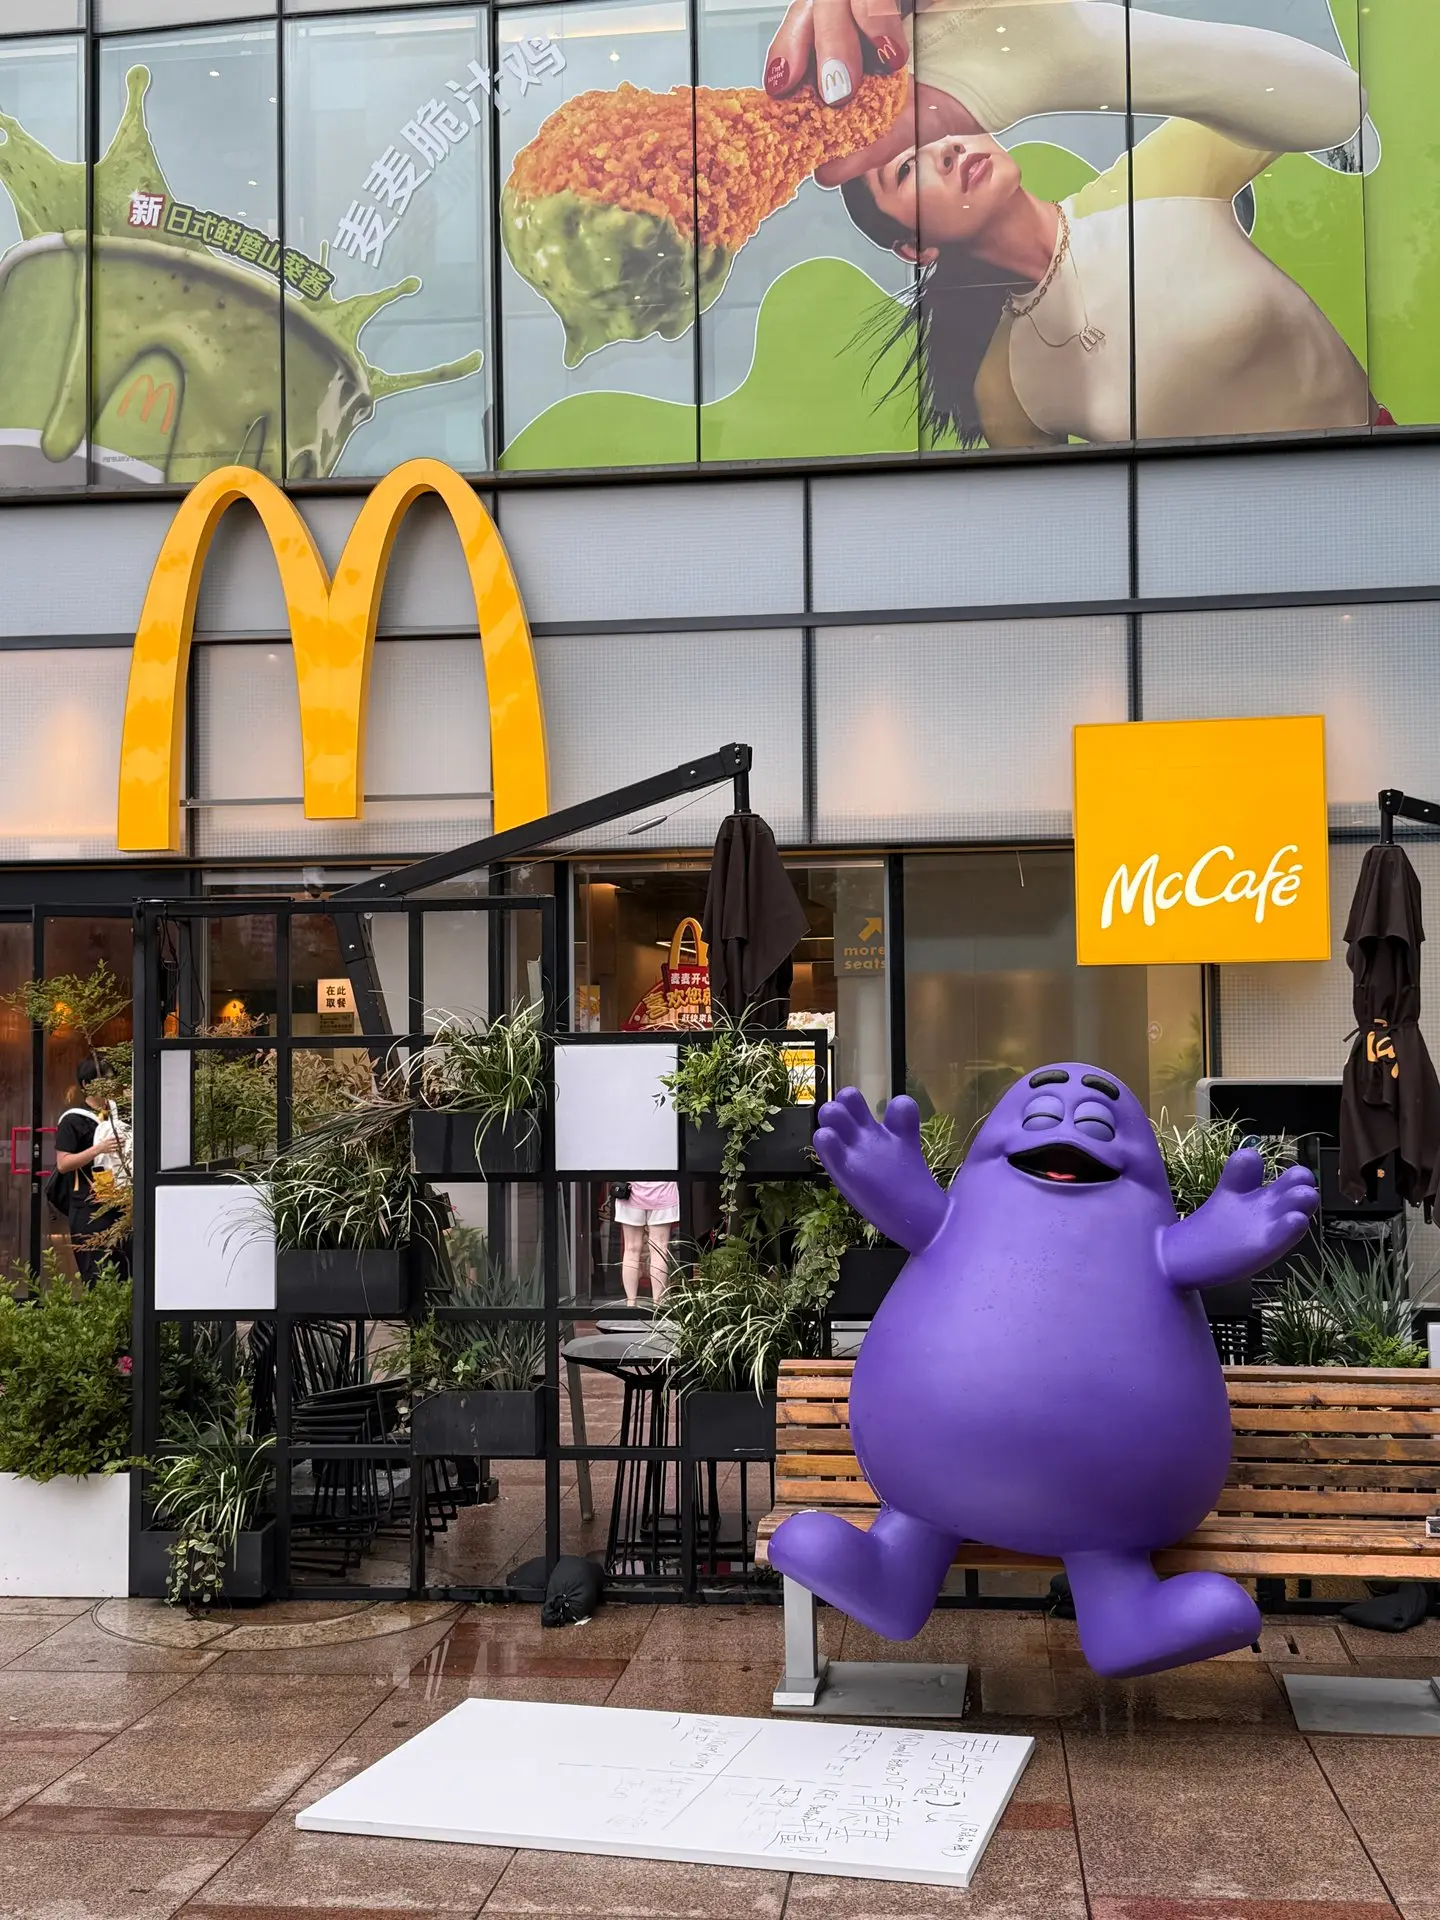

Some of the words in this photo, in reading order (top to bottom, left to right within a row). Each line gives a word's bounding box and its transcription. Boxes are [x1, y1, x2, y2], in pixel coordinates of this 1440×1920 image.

[333, 36, 567, 268] 麦麦脆汁鸡
[130, 193, 164, 227] 新
[167, 205, 332, 299] 日式鲜磨山葵酱
[1101, 844, 1304, 929] McCafé
[843, 946, 886, 957] more
[843, 957, 888, 971] seats
[325, 985, 347, 996] 在此
[325, 997, 347, 1009] 取餐
